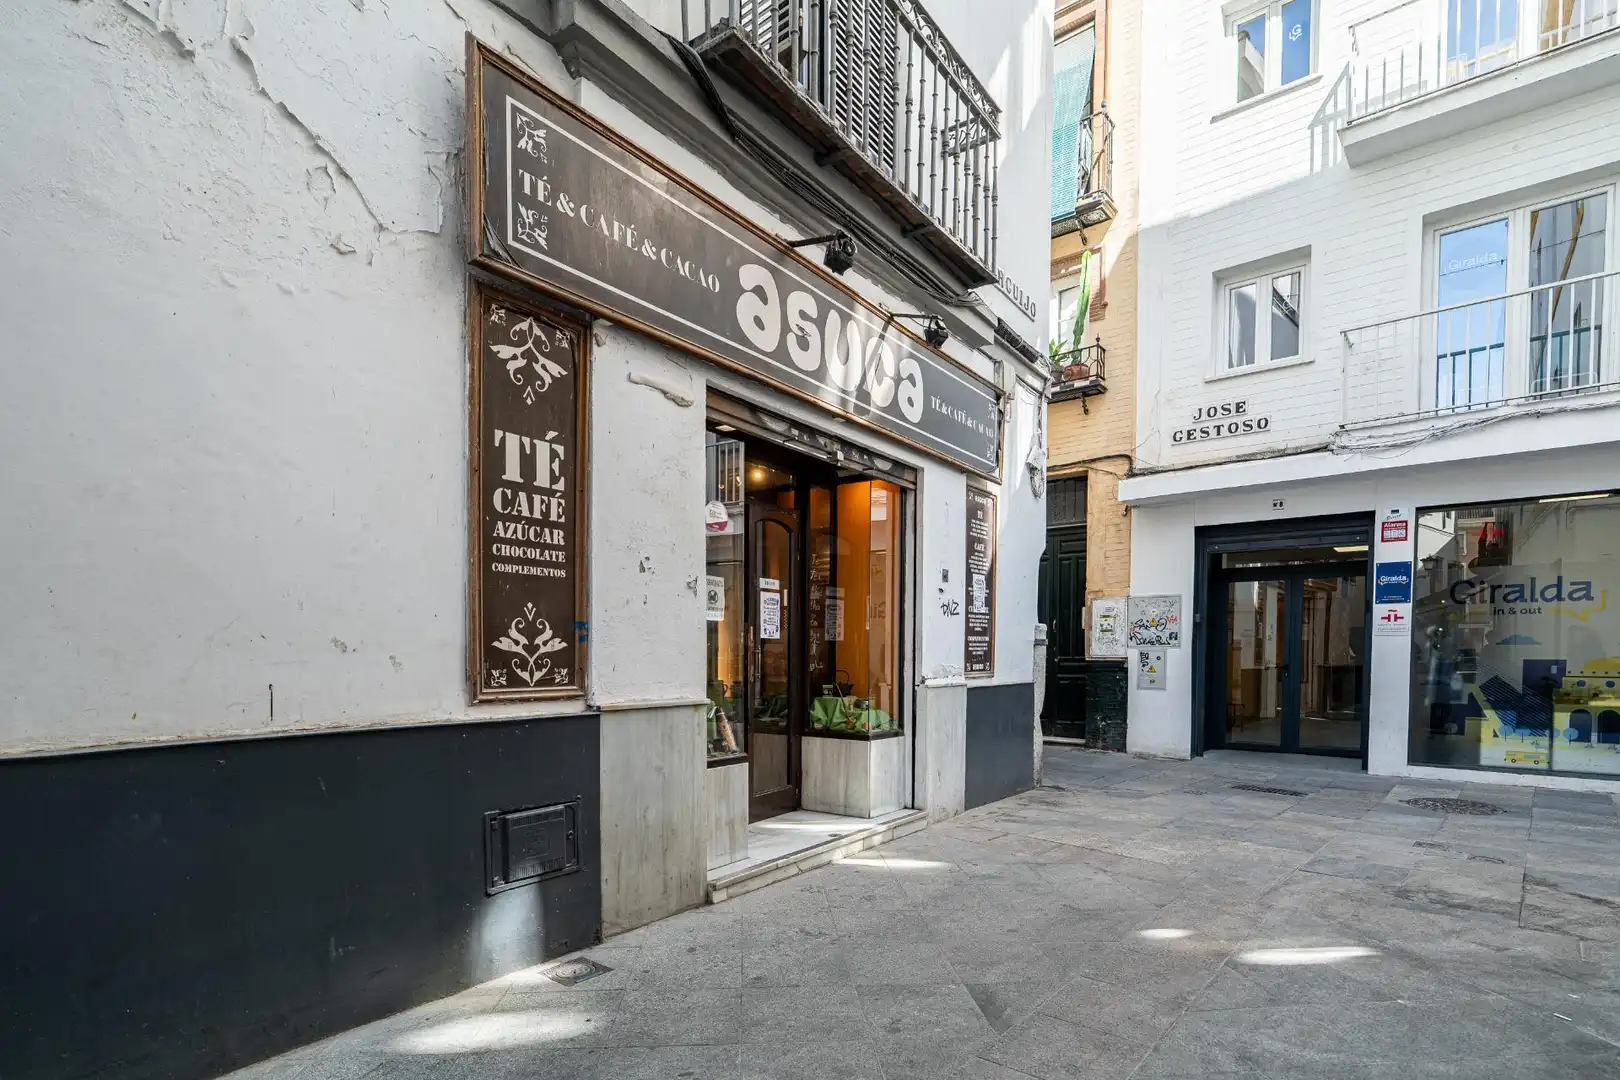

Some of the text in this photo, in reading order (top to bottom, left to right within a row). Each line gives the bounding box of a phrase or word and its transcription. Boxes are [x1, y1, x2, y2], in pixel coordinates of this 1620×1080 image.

[996, 268, 1036, 318] RGUIJO
[736, 263, 924, 424] asuca
[1193, 400, 1247, 421] JOSE
[1172, 417, 1269, 443] GESTOSO
[494, 428, 565, 491] TÉ
[493, 487, 566, 523] CAFÉ
[492, 520, 566, 546] AZÚCAR
[492, 543, 566, 563] CHOCOLATE
[491, 562, 567, 578] COMPLEMENTOS
[1450, 575, 1594, 605] Giralda
[1493, 606, 1542, 616] in & out
